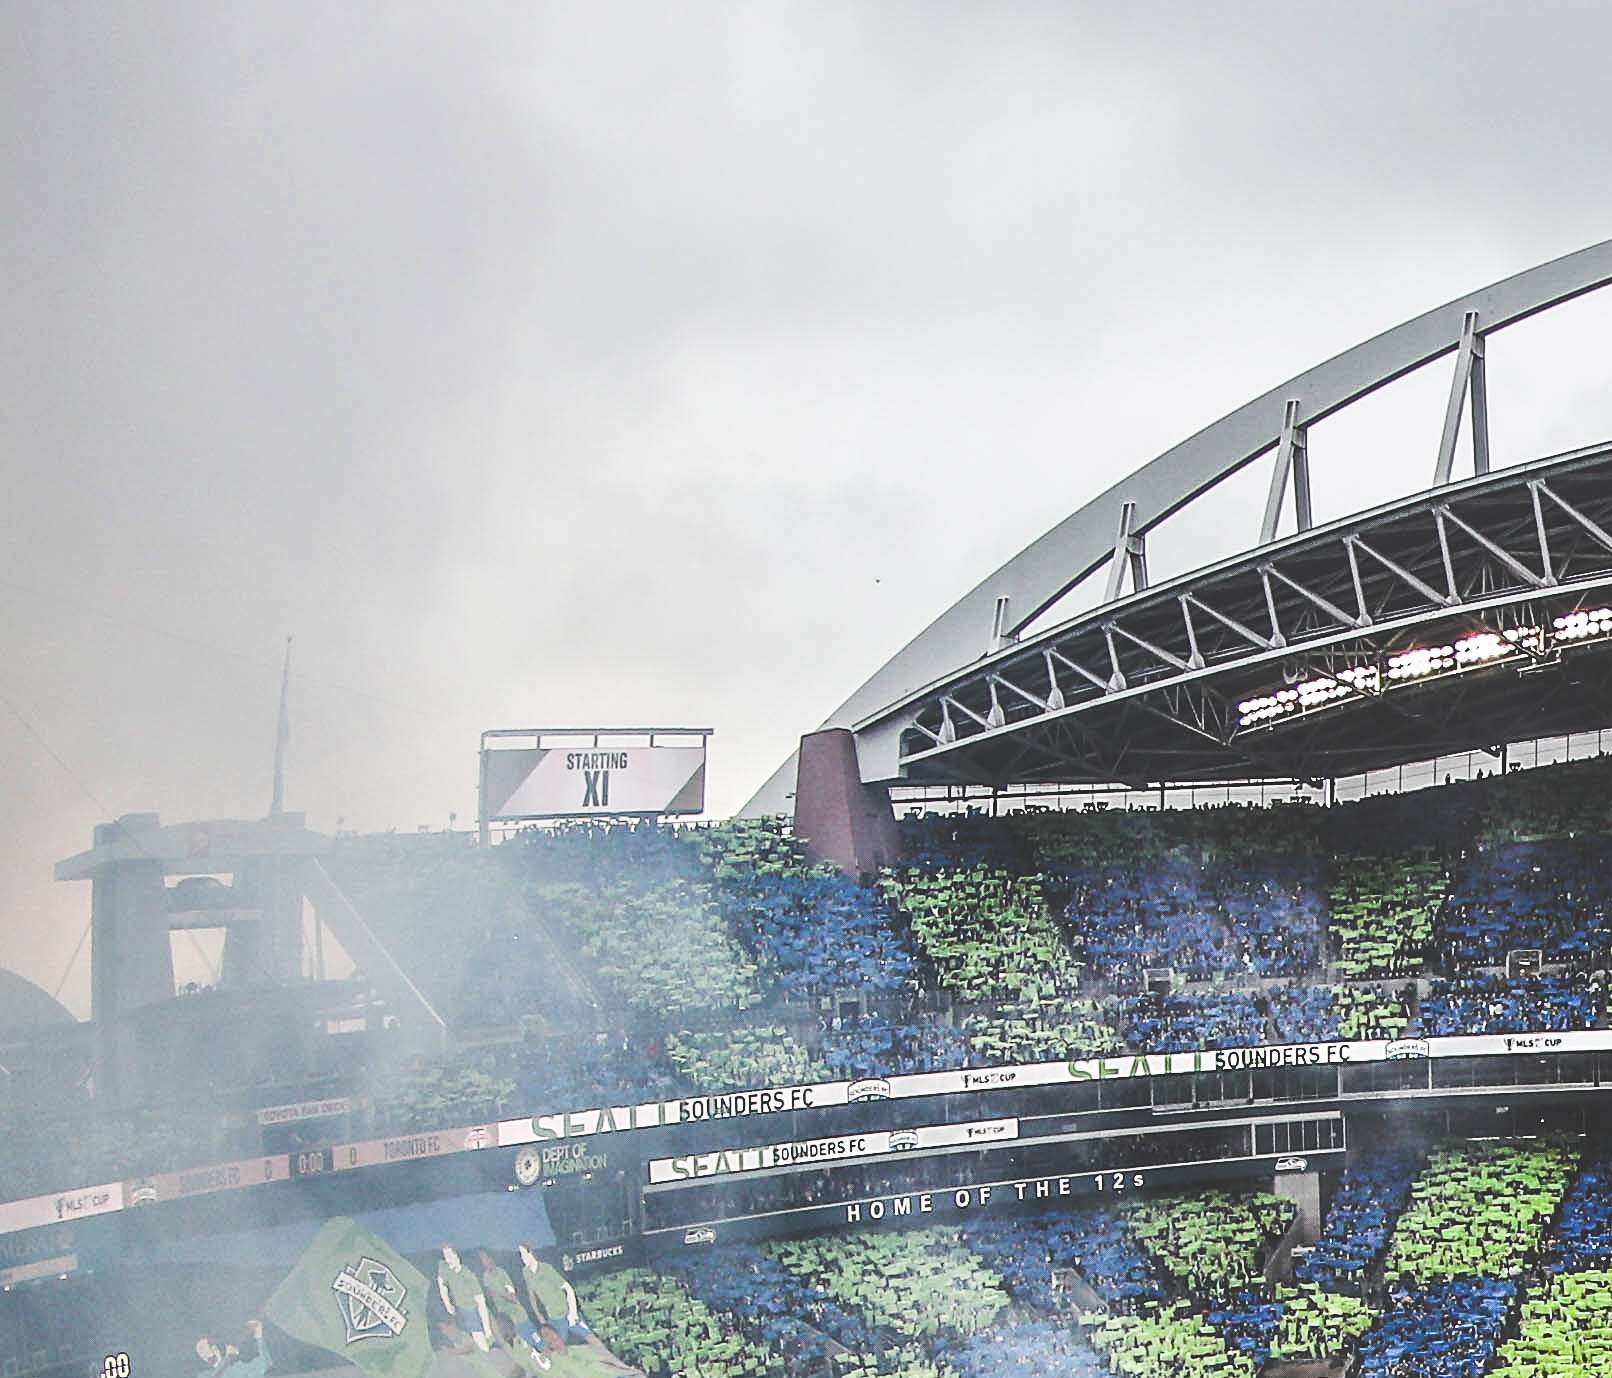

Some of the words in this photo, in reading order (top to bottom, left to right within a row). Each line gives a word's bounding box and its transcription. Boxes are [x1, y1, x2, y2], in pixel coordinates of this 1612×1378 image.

[566, 752, 628, 770] STARTING
[582, 770, 609, 807] XI
[1516, 1040, 1533, 1048] MLS
[1545, 1038, 1562, 1047] CUP
[1215, 1046, 1320, 1070] SOUNDERS
[1327, 1044, 1350, 1063] FC
[972, 1075, 990, 1084] MLS
[1000, 1073, 1016, 1082] CUP
[680, 1090, 785, 1121] SOUNDERS
[791, 1088, 814, 1109] FC
[383, 1138, 427, 1160] TORONTO
[428, 1136, 441, 1151] FC
[542, 1147, 566, 1163] DEPT
[568, 1142, 586, 1158] OF
[773, 1141, 846, 1163] SOUNDERS
[850, 1138, 866, 1152] FC
[543, 1153, 608, 1175] IMAGINATION
[847, 1196, 933, 1223] HOME
[955, 1188, 992, 1209] OF
[1014, 1178, 1071, 1200] THE
[1095, 1173, 1145, 1191] 12s
[575, 1246, 624, 1264] STARBUCKS
